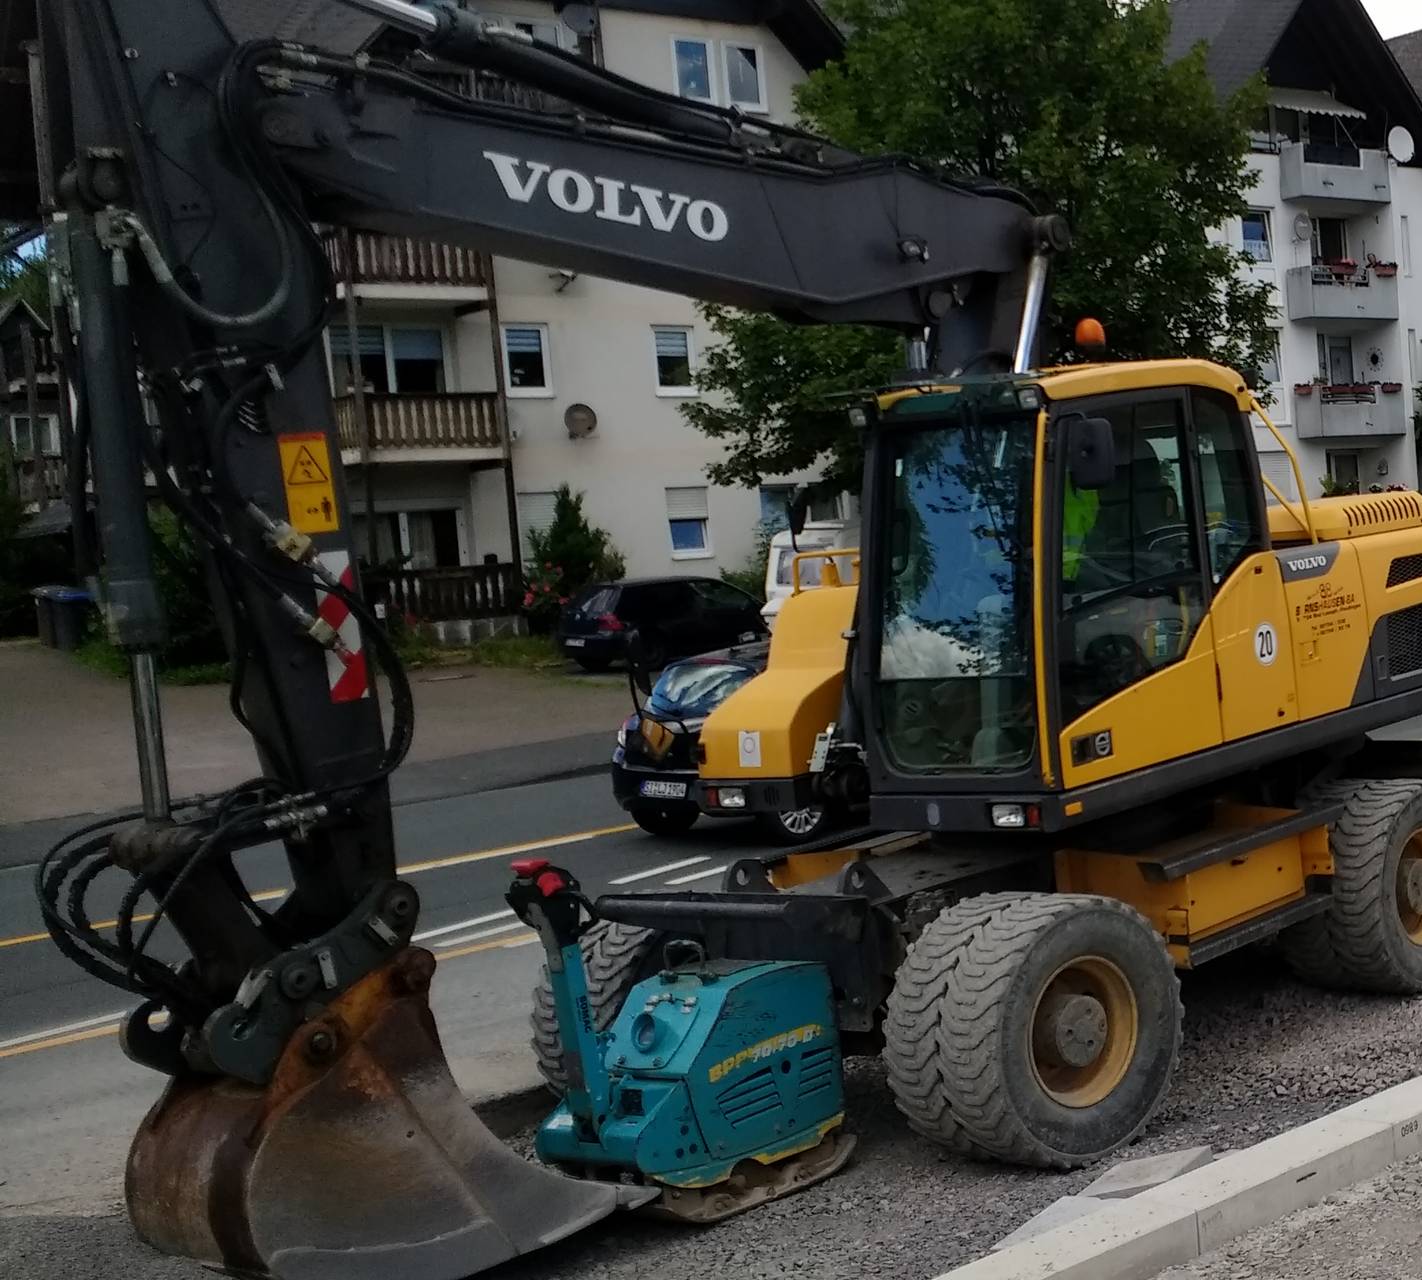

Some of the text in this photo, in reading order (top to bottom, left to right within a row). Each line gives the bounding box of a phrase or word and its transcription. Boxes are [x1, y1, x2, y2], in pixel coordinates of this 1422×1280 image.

[483, 151, 728, 241] VOLVO
[1288, 556, 1327, 571] VOLVO
[1258, 630, 1273, 658] 20
[579, 995, 592, 1034] BOMAG
